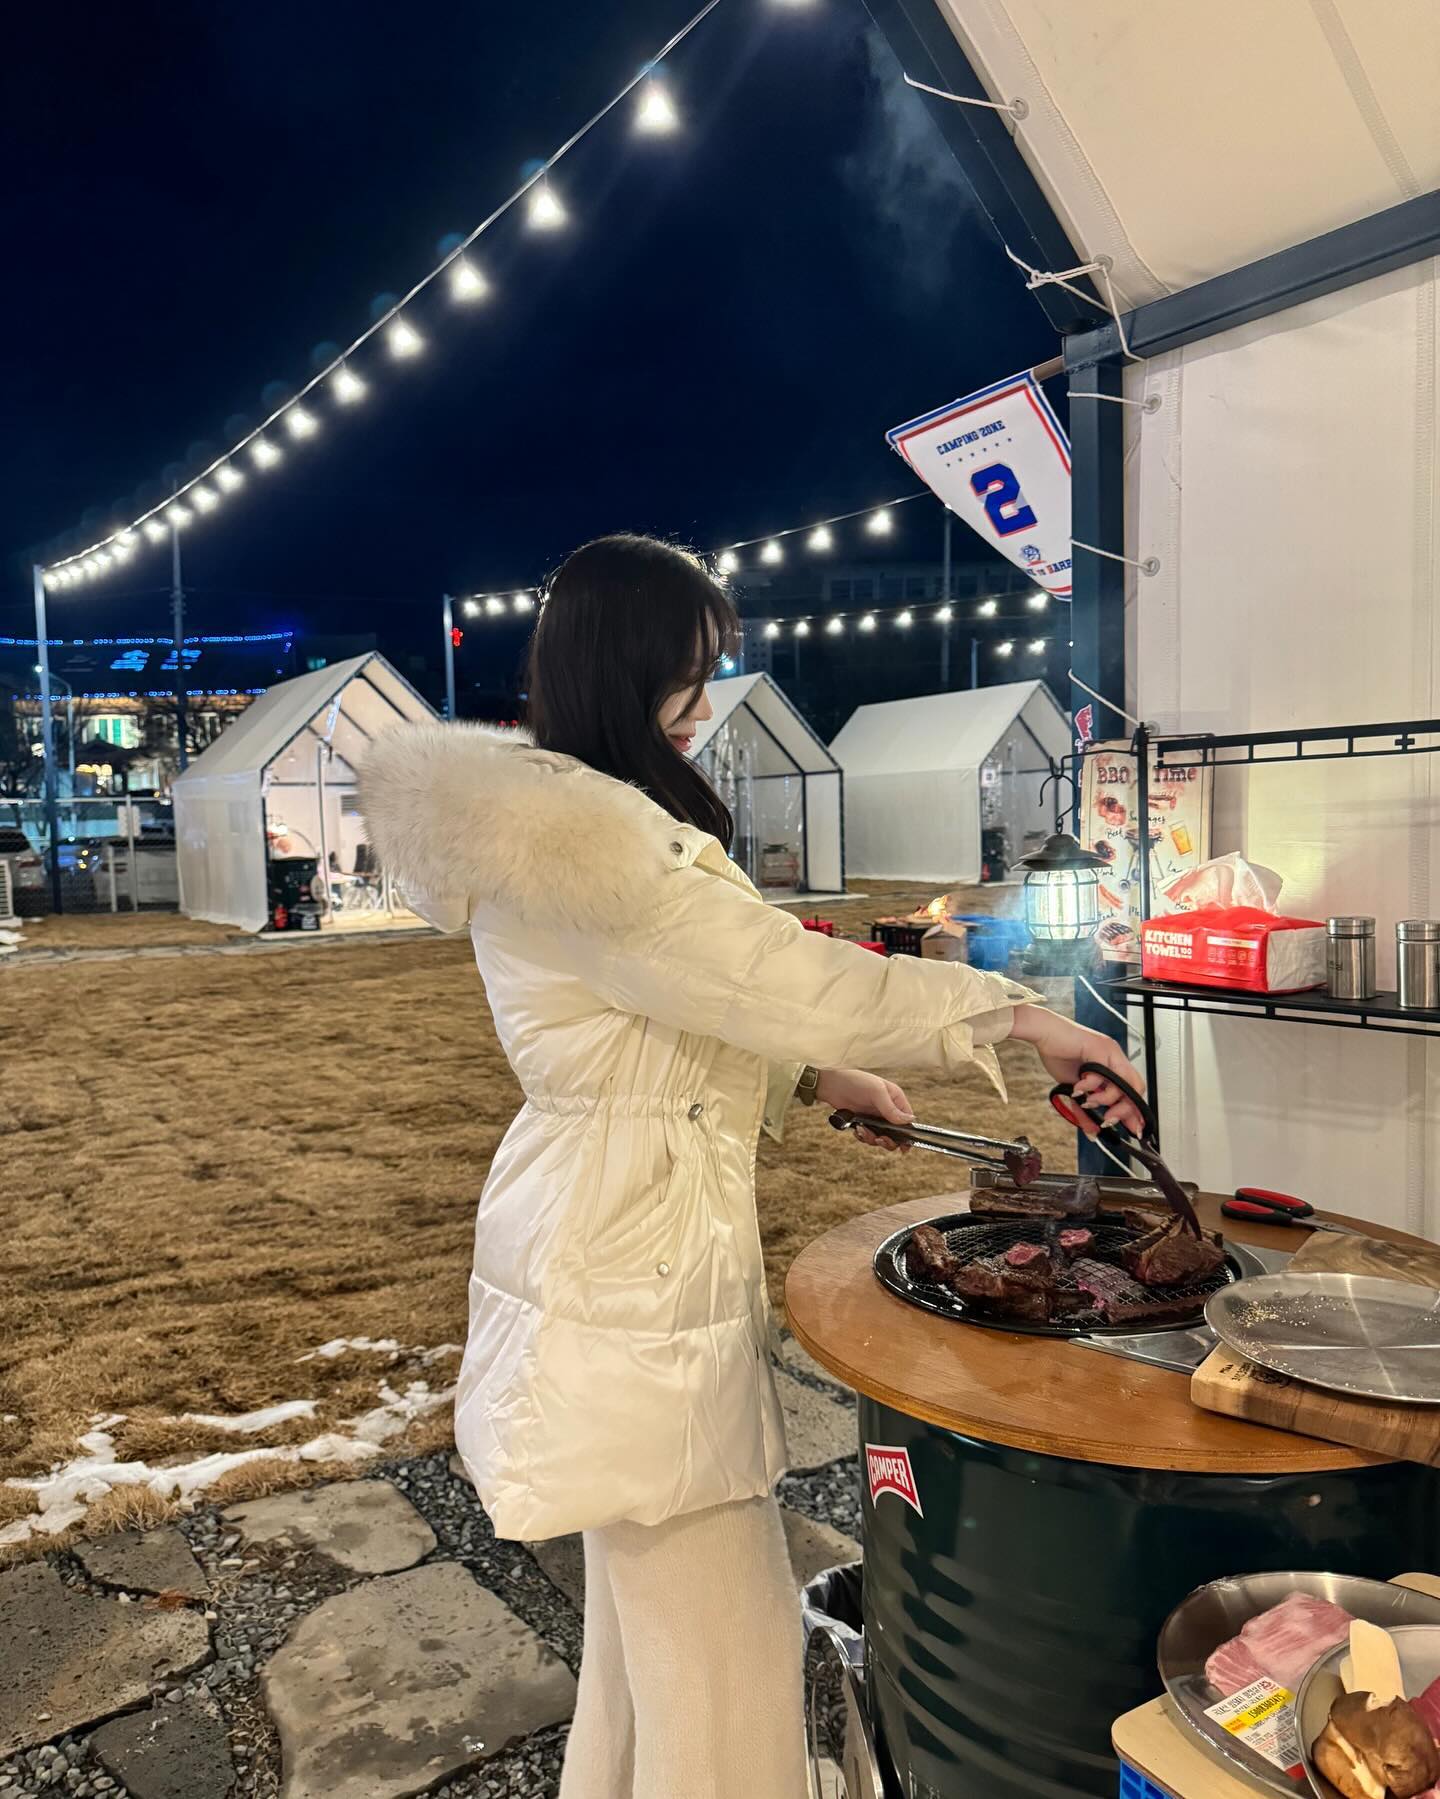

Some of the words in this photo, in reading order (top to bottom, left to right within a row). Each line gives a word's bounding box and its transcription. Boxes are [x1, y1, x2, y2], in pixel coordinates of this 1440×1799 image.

[936, 430, 979, 455] CAMPING
[978, 420, 1006, 437] ZONE
[970, 461, 1038, 538] 2
[1097, 766, 1130, 784] BBQ
[1153, 765, 1198, 783] Time
[1144, 929, 1193, 947] KITCHEN
[1145, 943, 1180, 958] TOWEL
[869, 1454, 911, 1492] CAMPER
